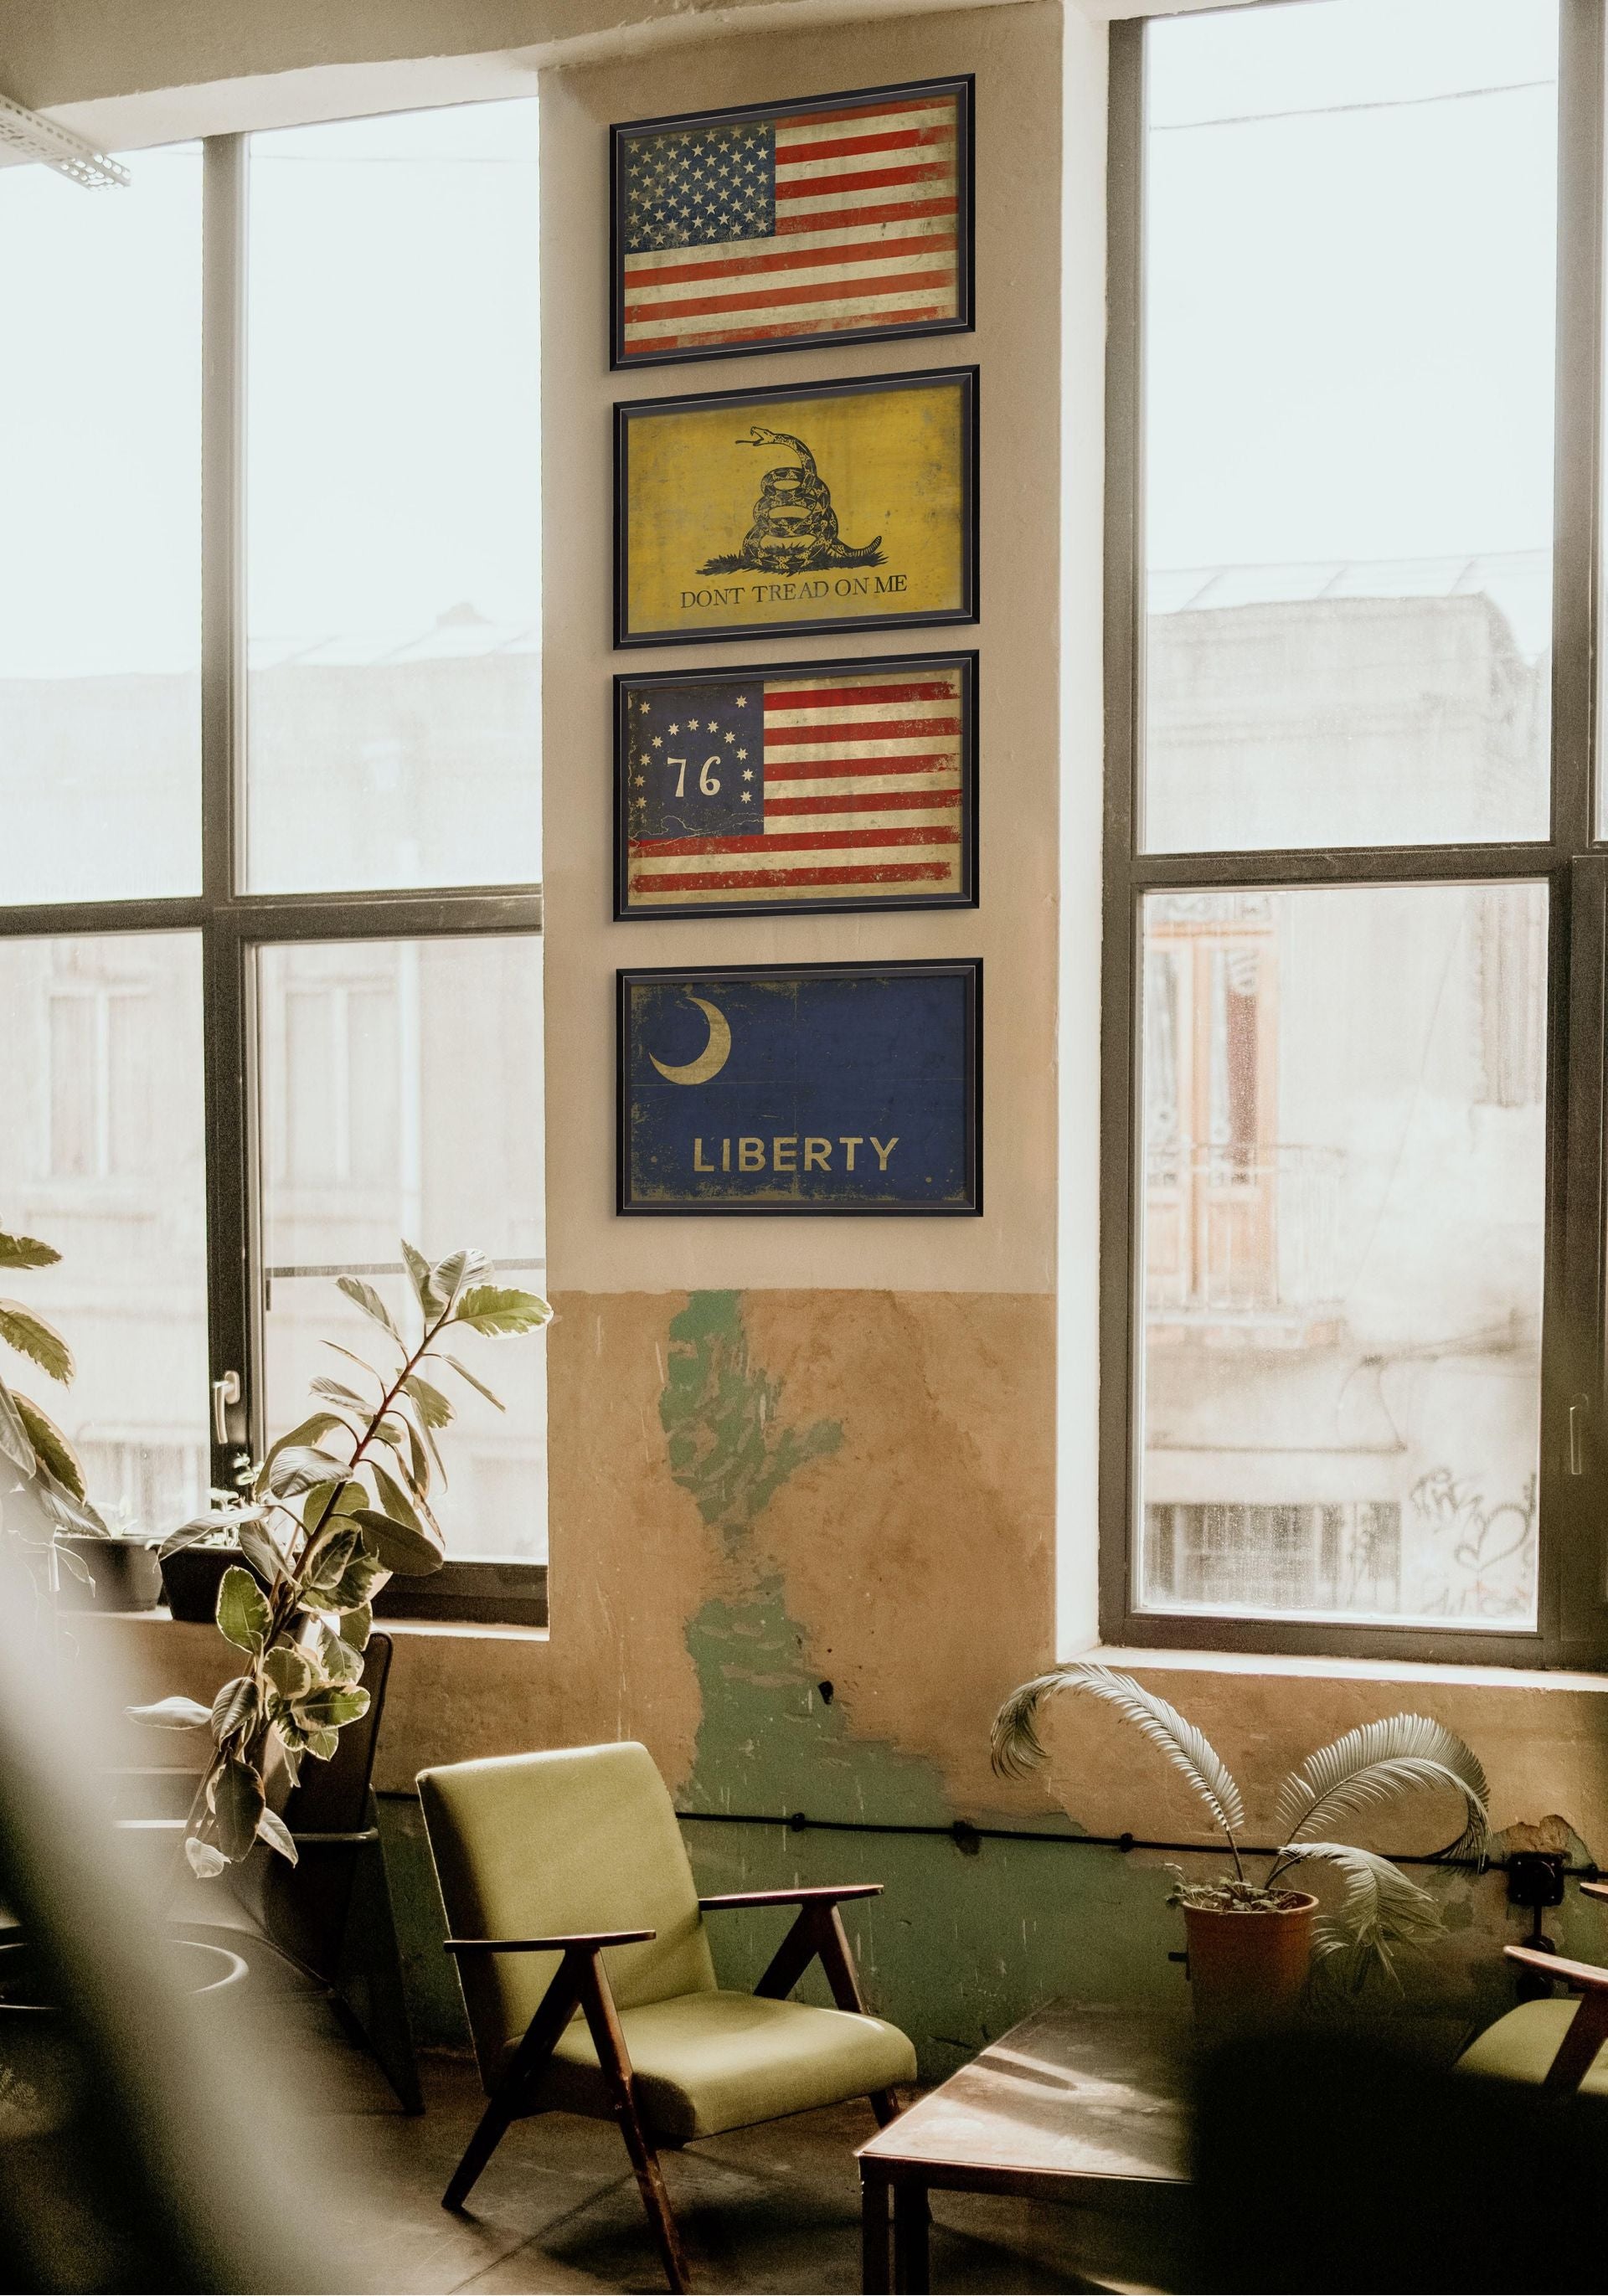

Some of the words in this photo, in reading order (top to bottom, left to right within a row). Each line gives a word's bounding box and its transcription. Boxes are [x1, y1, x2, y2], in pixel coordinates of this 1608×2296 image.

[680, 587, 745, 609] DONT
[752, 580, 829, 602] TREAD
[834, 577, 870, 597] ON
[874, 574, 908, 594] ME
[667, 755, 721, 797] 76
[693, 1136, 899, 1172] LIBERTY
